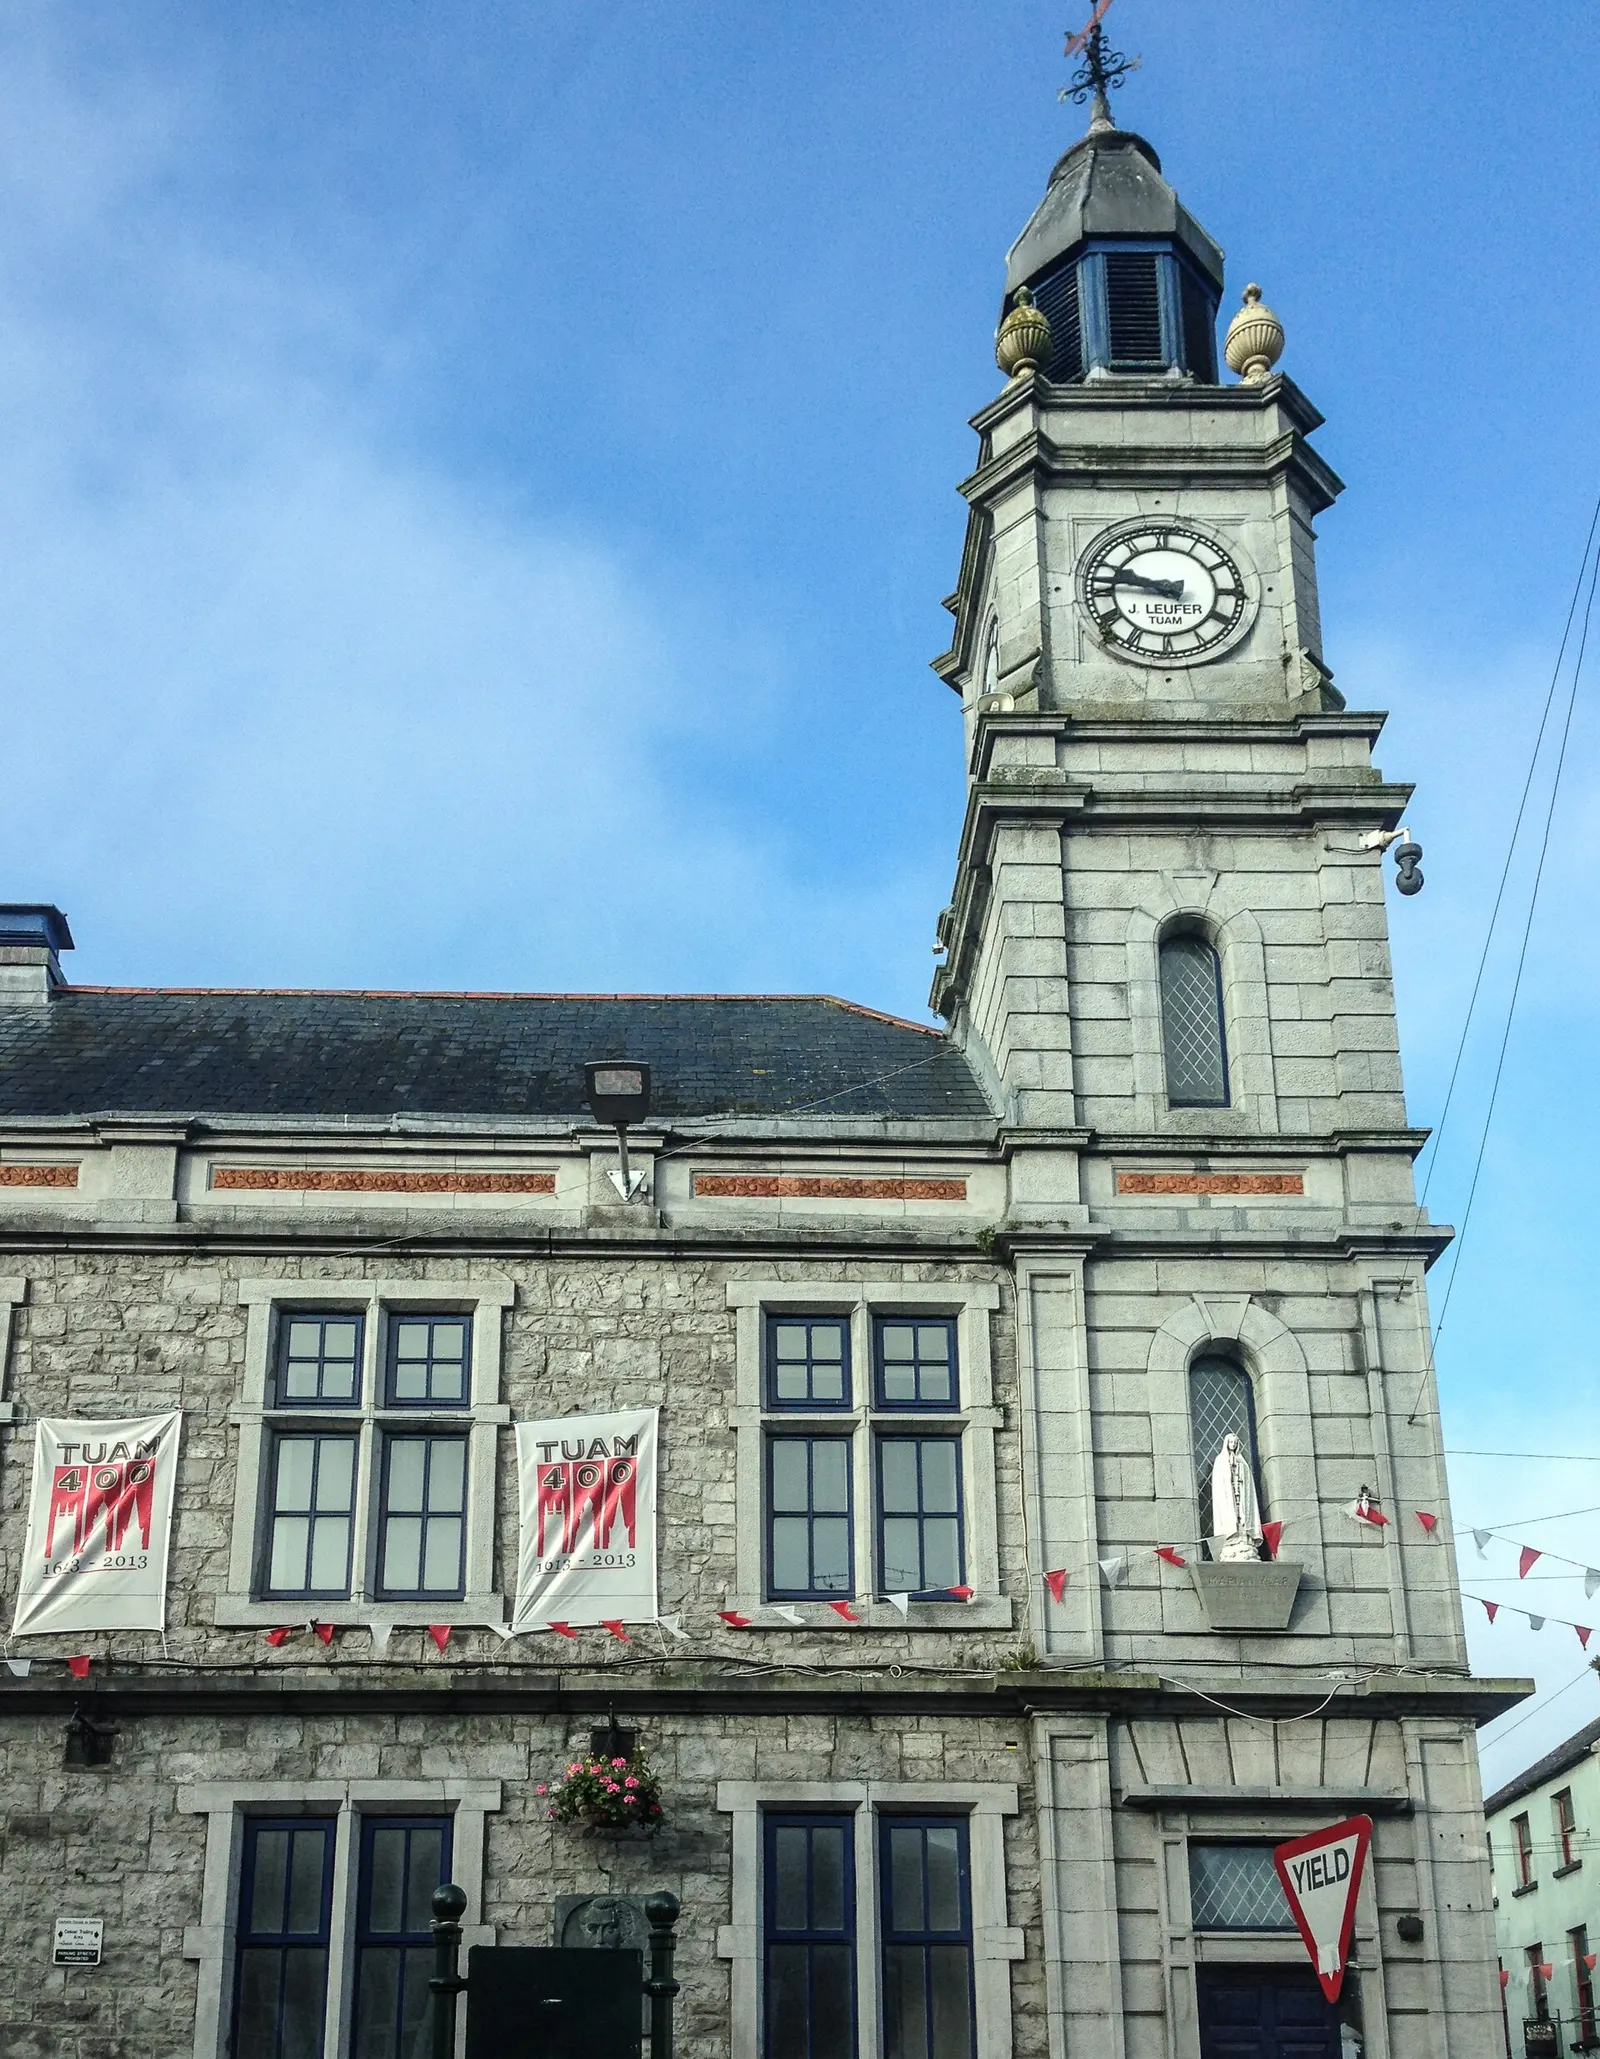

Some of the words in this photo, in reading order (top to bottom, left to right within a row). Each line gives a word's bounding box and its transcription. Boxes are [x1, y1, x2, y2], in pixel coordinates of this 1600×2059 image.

[1146, 604, 1202, 614] LEUFER
[1148, 616, 1182, 625] TUAM
[57, 1436, 161, 1464] TUAM
[536, 1434, 639, 1462] TUAM
[58, 1465, 150, 1491] 400
[543, 1461, 632, 1490] 400
[104, 1555, 148, 1569] 2013
[593, 1553, 636, 1568] 2013
[1292, 1847, 1350, 1894] YIELD
